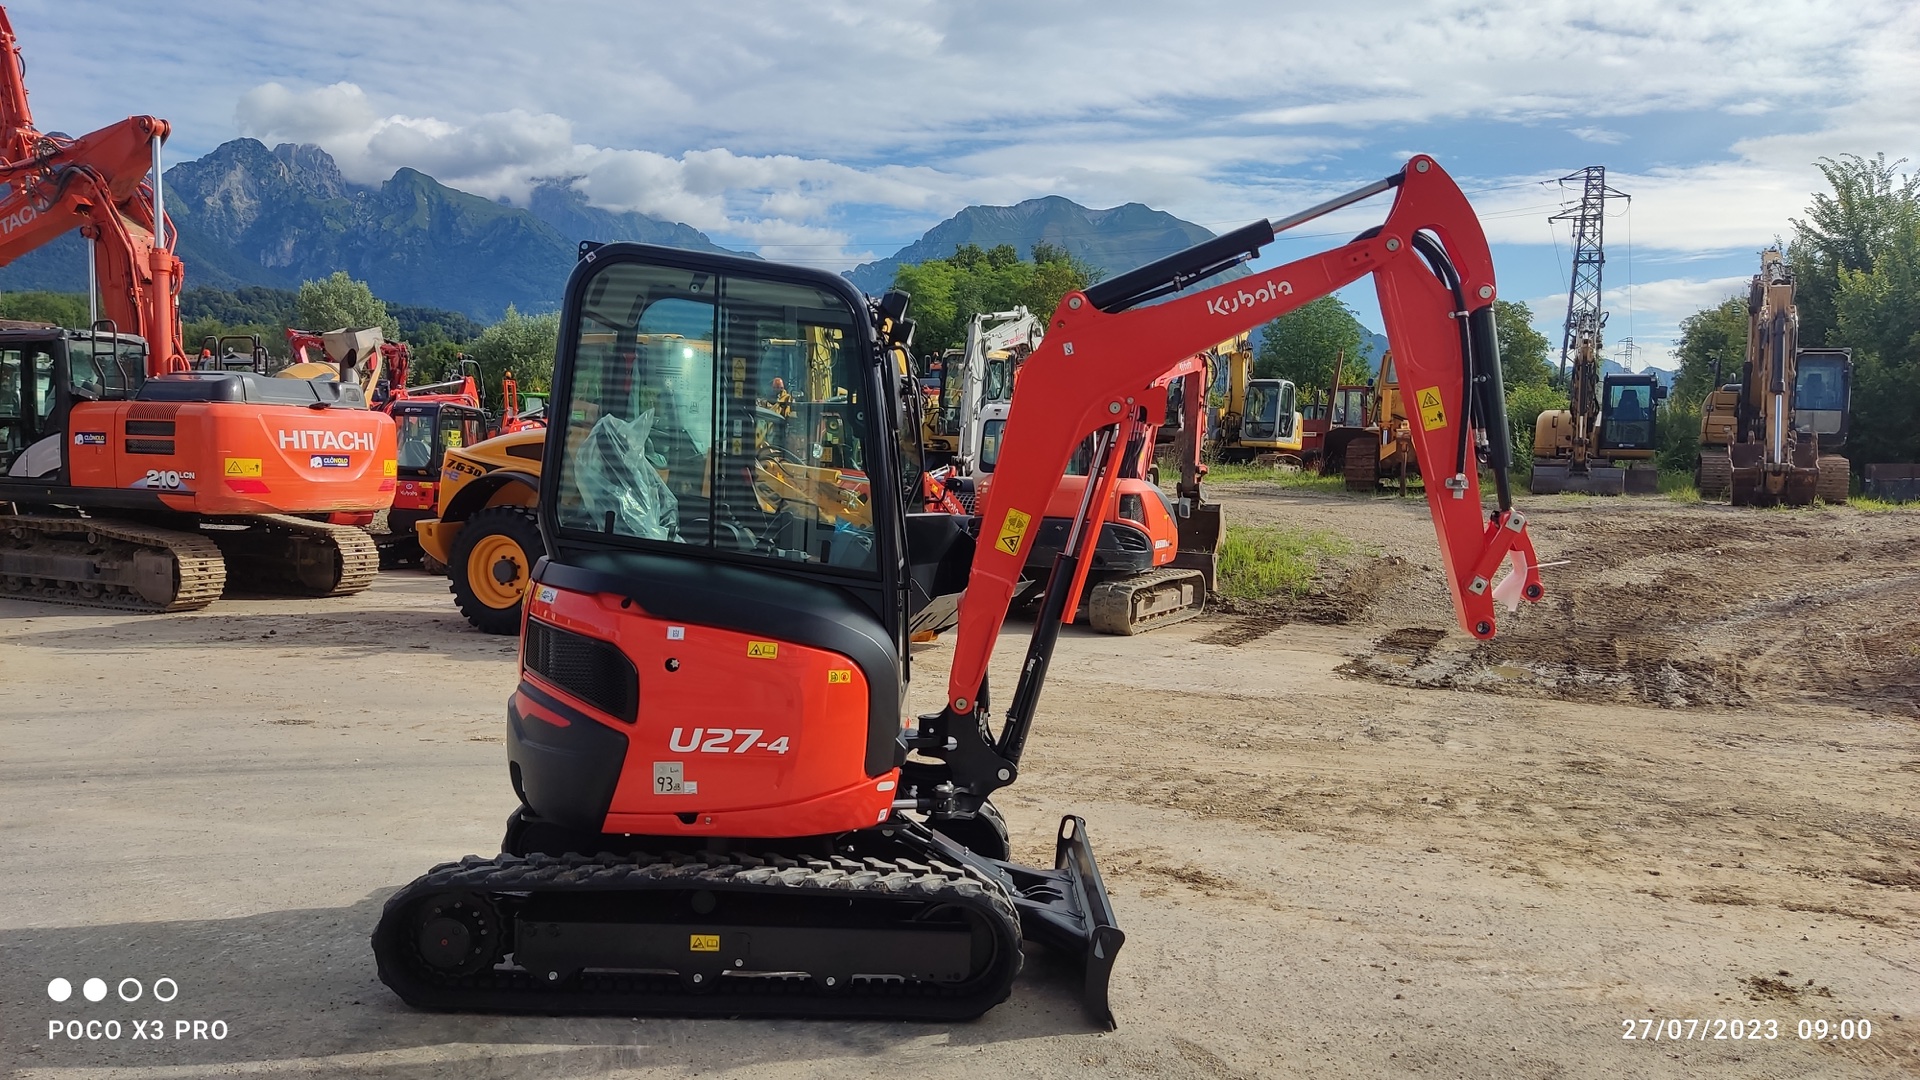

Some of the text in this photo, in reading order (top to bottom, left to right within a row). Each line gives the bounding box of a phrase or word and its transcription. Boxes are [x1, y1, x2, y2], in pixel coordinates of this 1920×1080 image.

[1206, 280, 1293, 316] Kubota
[278, 430, 374, 451] HITACHI
[146, 469, 195, 489] 210 LCN
[668, 727, 790, 755] U27-4
[657, 776, 673, 792] 93
